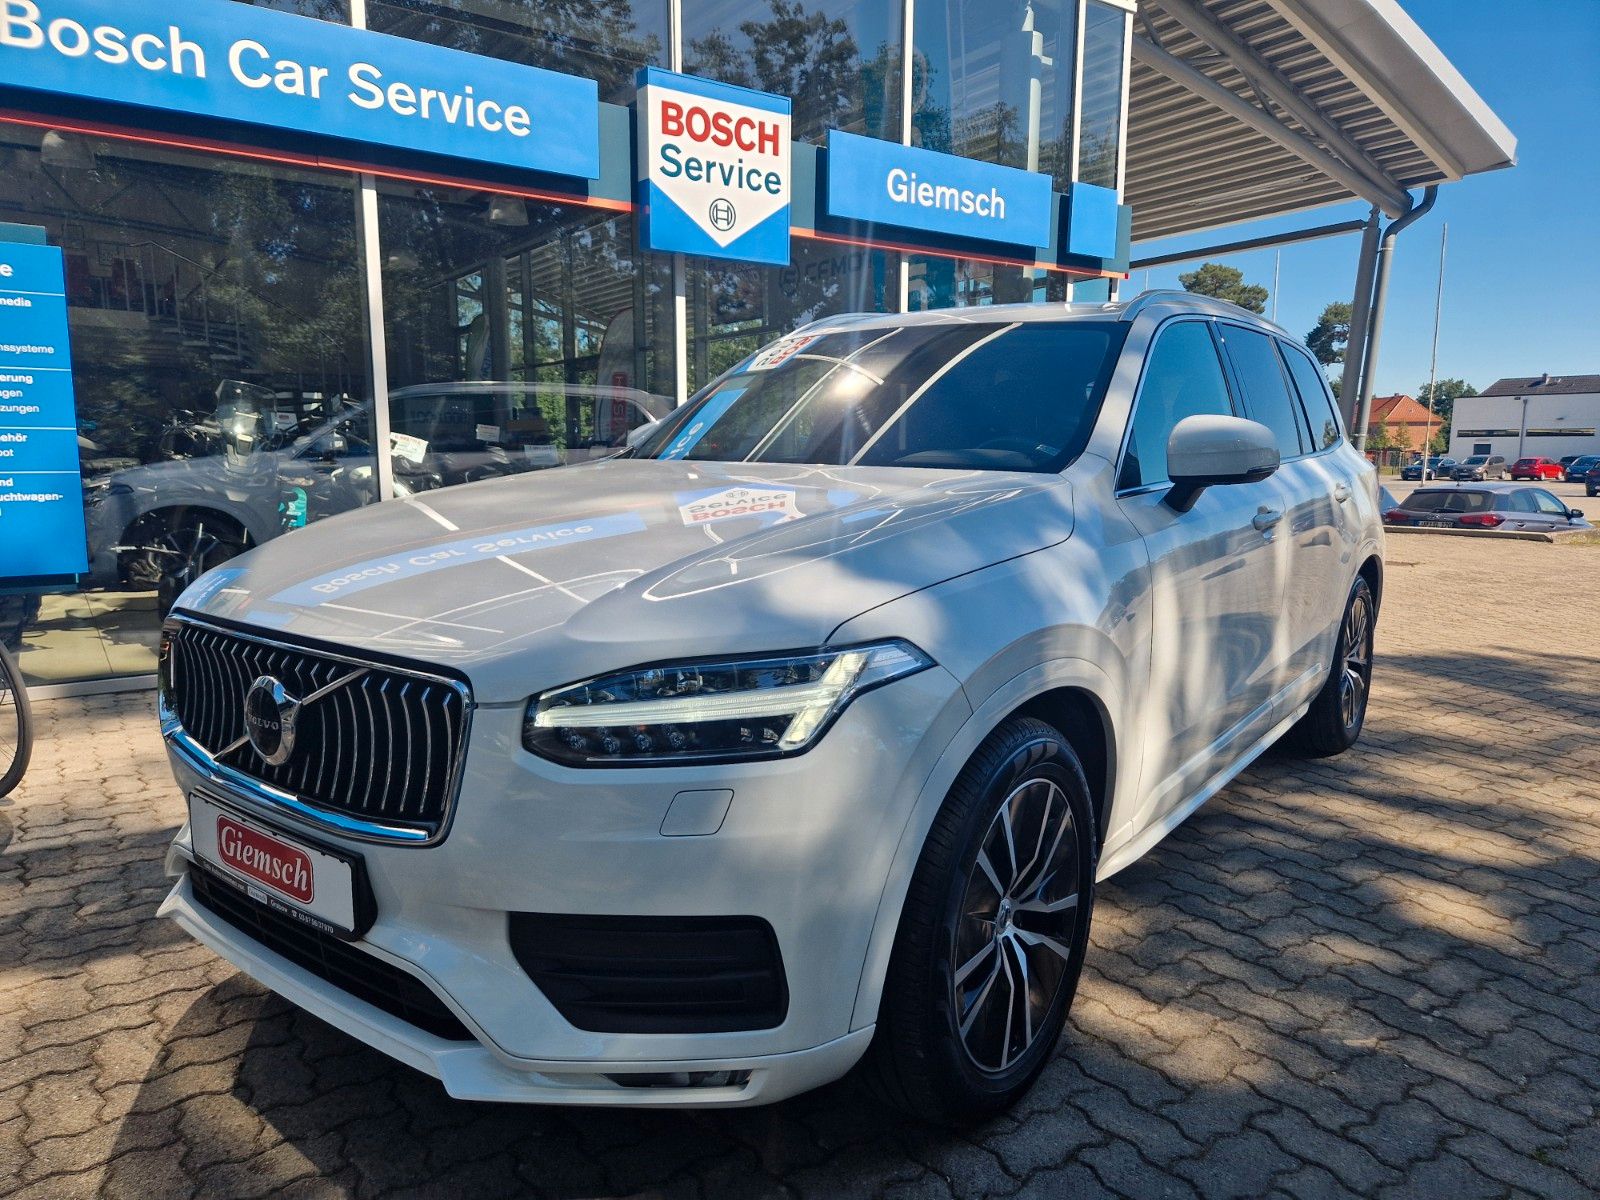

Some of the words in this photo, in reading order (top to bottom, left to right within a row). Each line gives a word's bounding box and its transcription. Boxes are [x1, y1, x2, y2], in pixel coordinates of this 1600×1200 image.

[0, 0, 206, 78] Bosch
[229, 40, 328, 99] Car
[348, 63, 531, 137] Service
[661, 100, 779, 156] BOSCH
[660, 144, 781, 194] Service
[886, 168, 1005, 219] Giemsch
[248, 712, 279, 730] VOLVO
[220, 825, 308, 891] Giemsch
